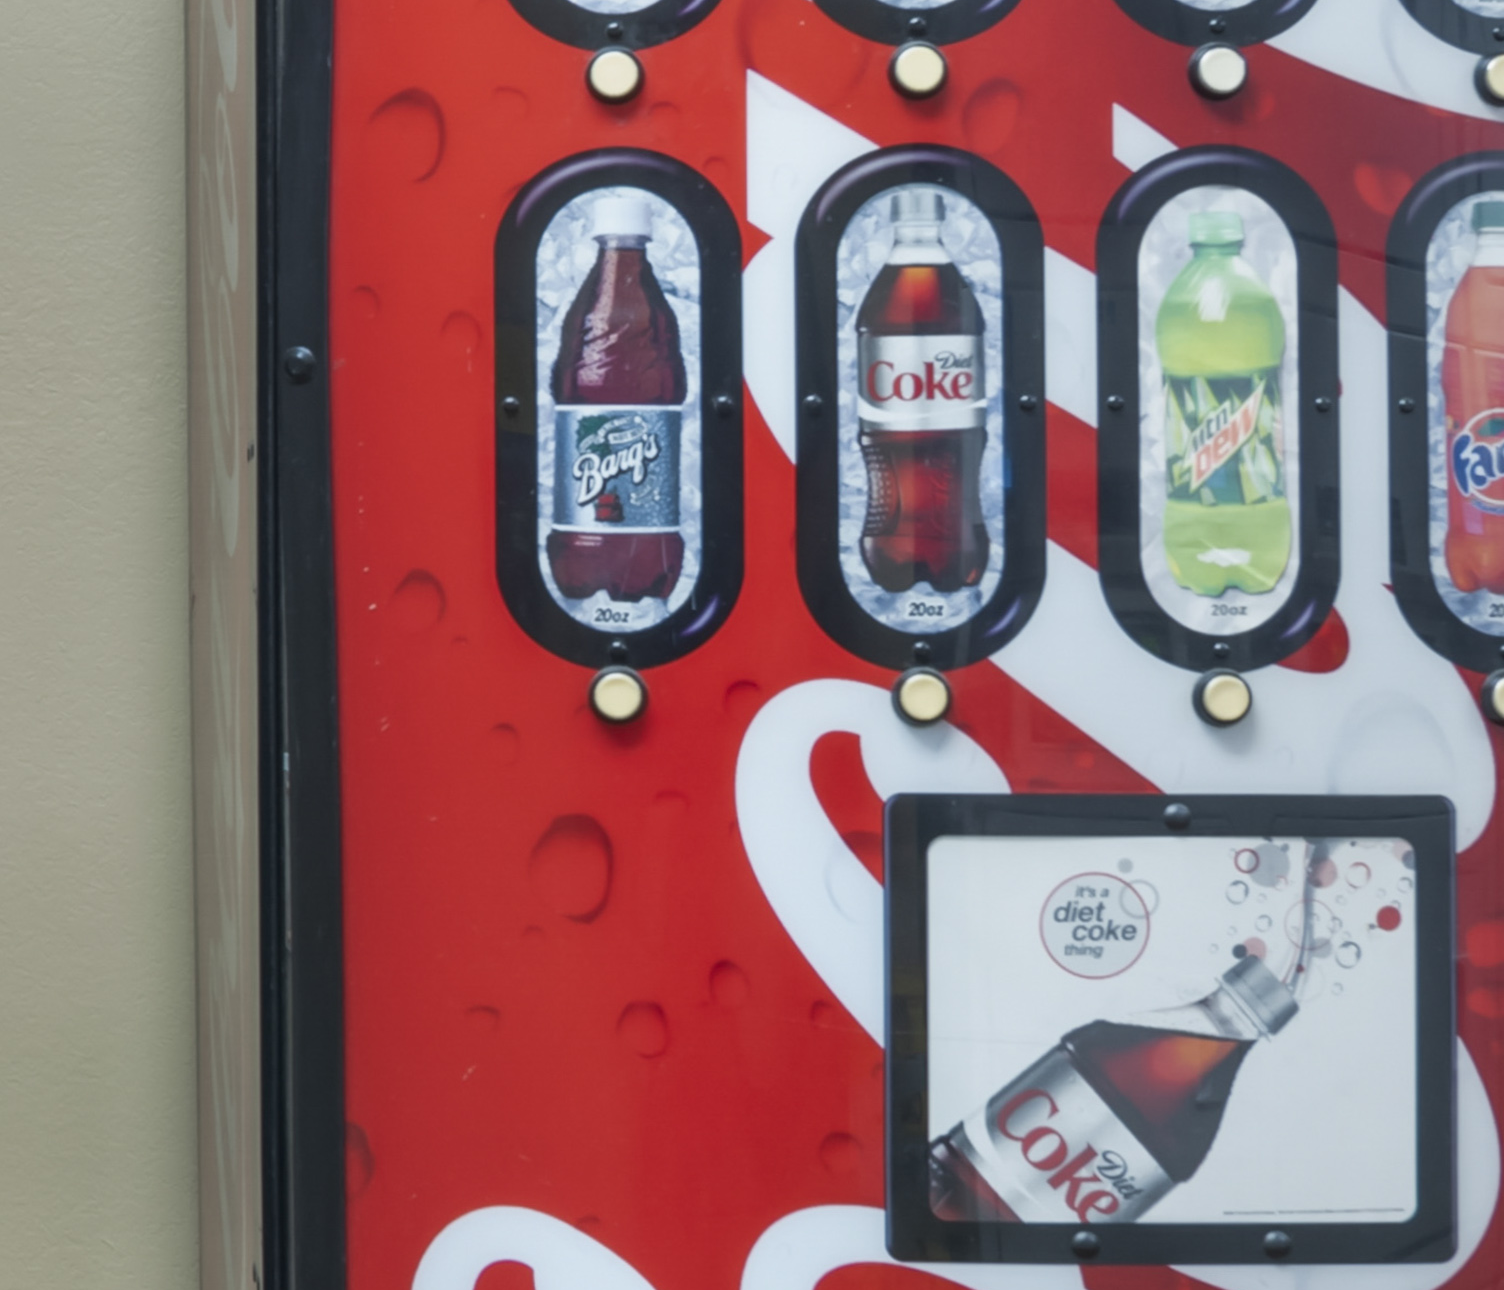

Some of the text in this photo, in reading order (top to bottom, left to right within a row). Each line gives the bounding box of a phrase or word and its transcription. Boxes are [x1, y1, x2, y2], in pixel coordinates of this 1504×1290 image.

[934, 350, 975, 371] Diet
[866, 360, 974, 403] Coke
[572, 434, 658, 504] Barq's
[594, 609, 629, 624] 20oz
[909, 603, 944, 618] 20oz
[1211, 604, 1247, 618] 20oz
[1075, 885, 1109, 899] it's a
[1054, 901, 1104, 924] diet
[1072, 919, 1137, 942] coke
[1064, 943, 1104, 959] thing
[996, 1087, 1121, 1223] Coke
[1096, 1150, 1144, 1201] Diet
